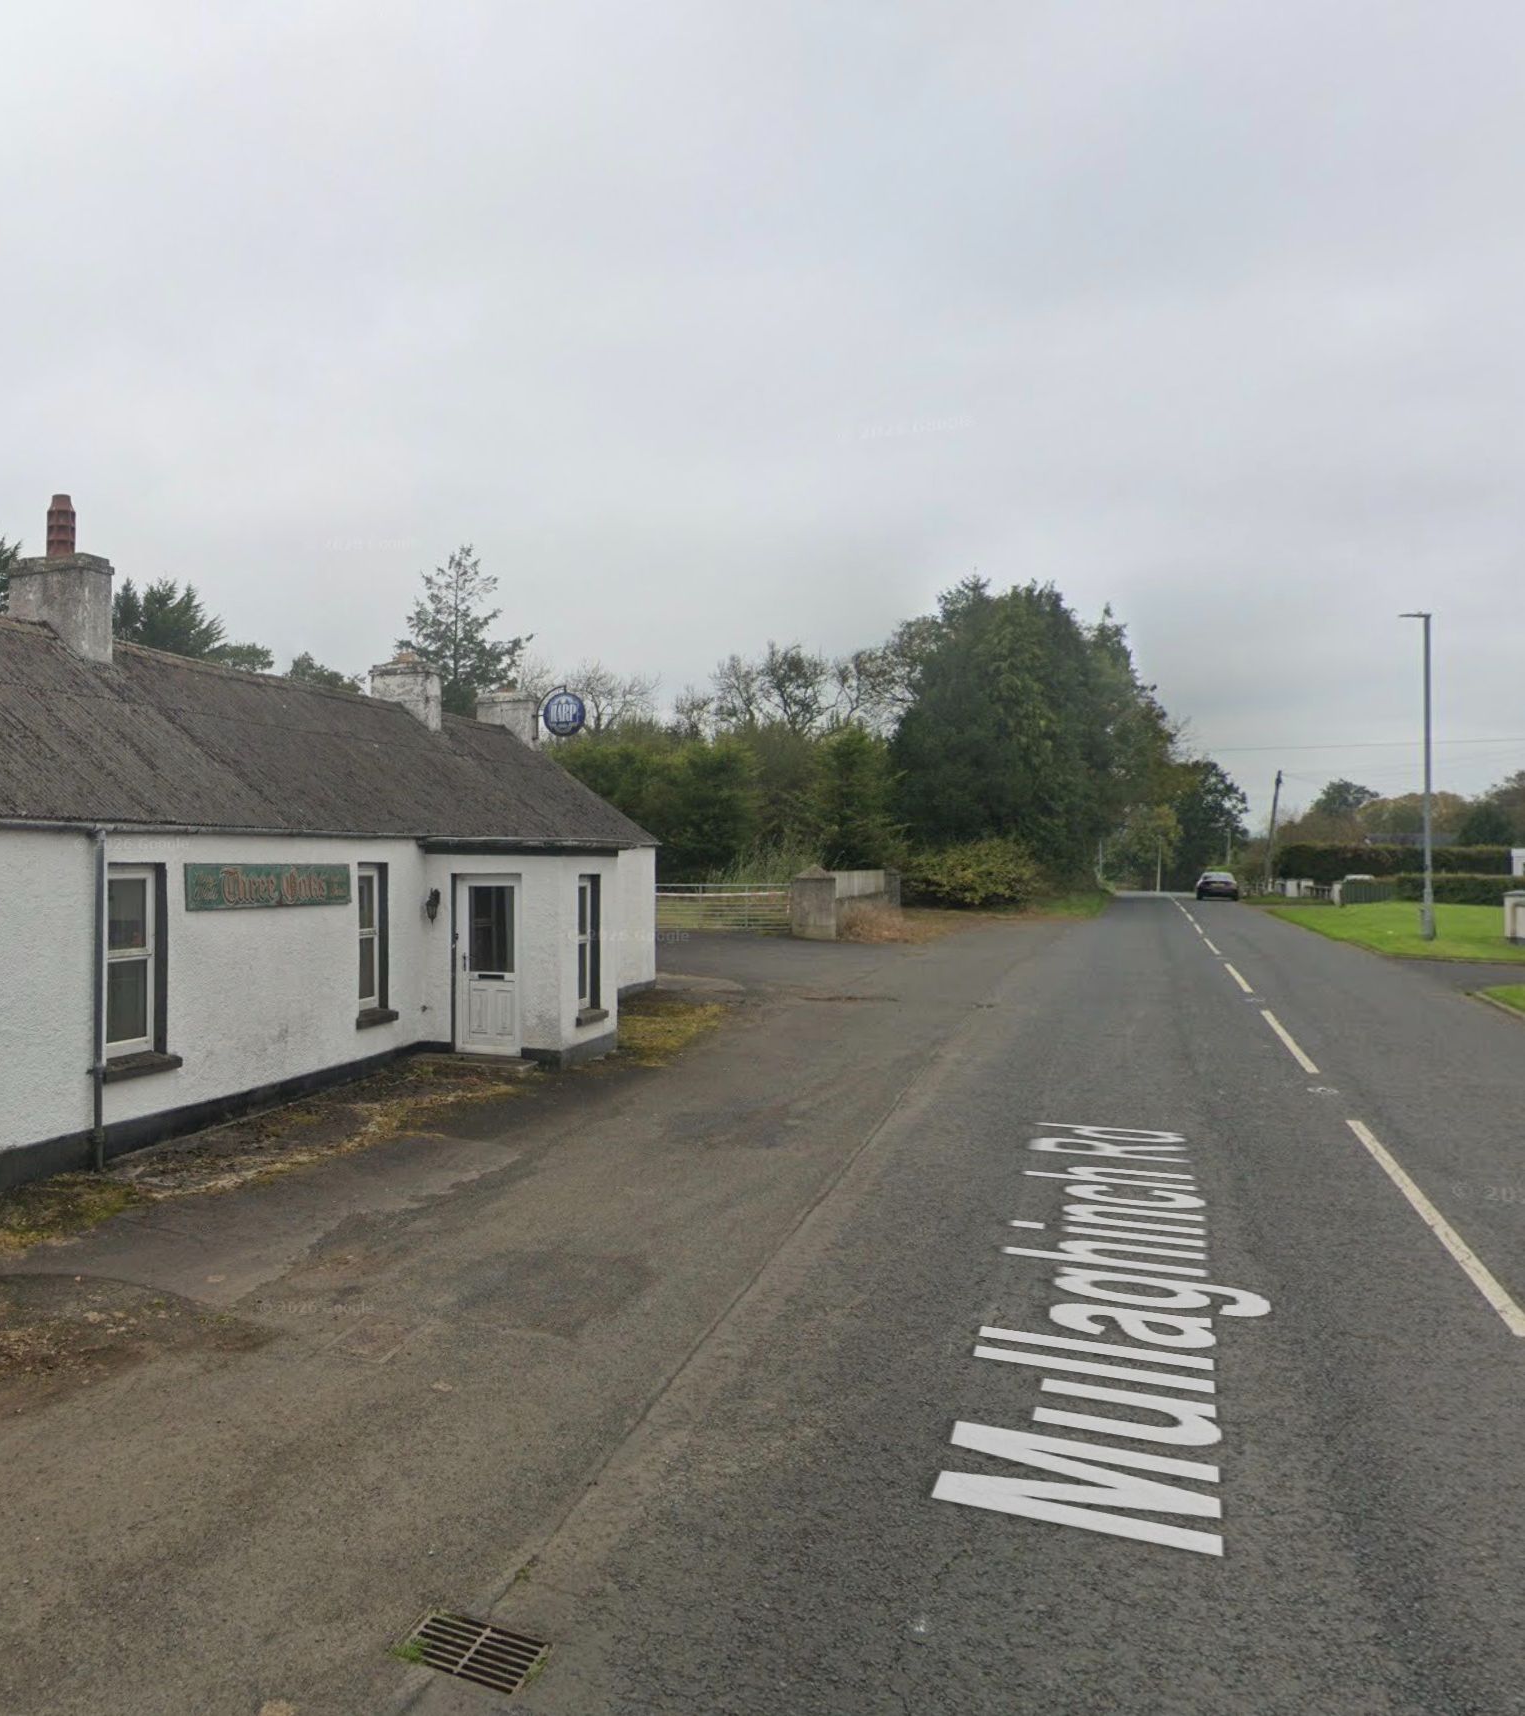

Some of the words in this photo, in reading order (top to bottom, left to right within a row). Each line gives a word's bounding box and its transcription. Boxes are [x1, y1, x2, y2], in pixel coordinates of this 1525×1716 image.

[549, 702, 578, 723] HARP
[220, 865, 279, 906] Three
[281, 864, 326, 905] Oaks
